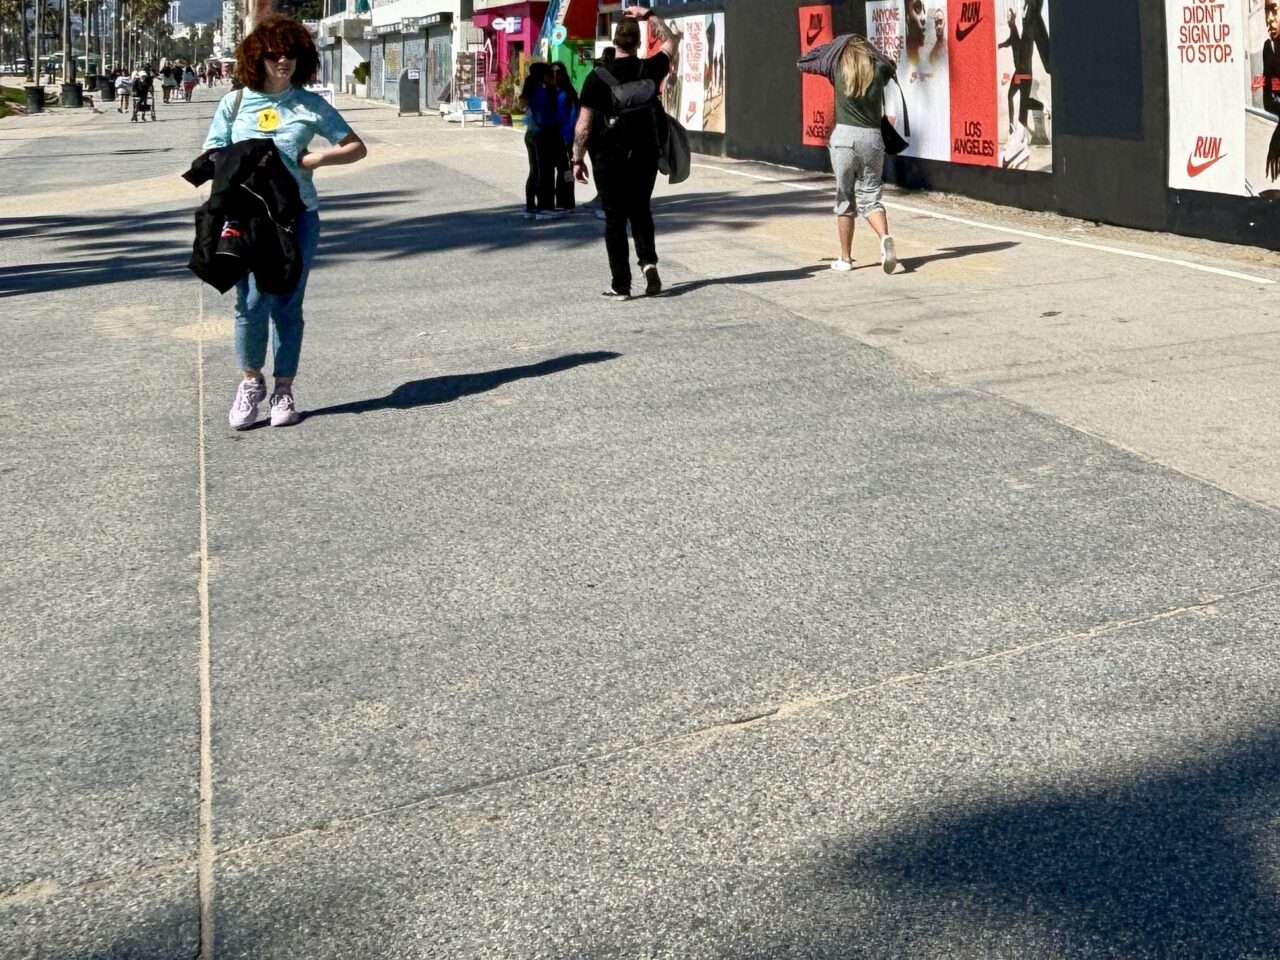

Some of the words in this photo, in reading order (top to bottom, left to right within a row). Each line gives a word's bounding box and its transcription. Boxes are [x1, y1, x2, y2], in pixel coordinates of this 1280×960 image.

[960, 2, 980, 23] RUN
[1183, 3, 1225, 24] DIDN'T
[1179, 24, 1210, 44] SIGN
[1213, 25, 1231, 43] UP
[1177, 44, 1195, 63] TO
[1198, 44, 1235, 63] STOP.
[964, 121, 982, 138] LOS
[953, 139, 994, 157] ANGELES
[1194, 135, 1222, 159] RUN
